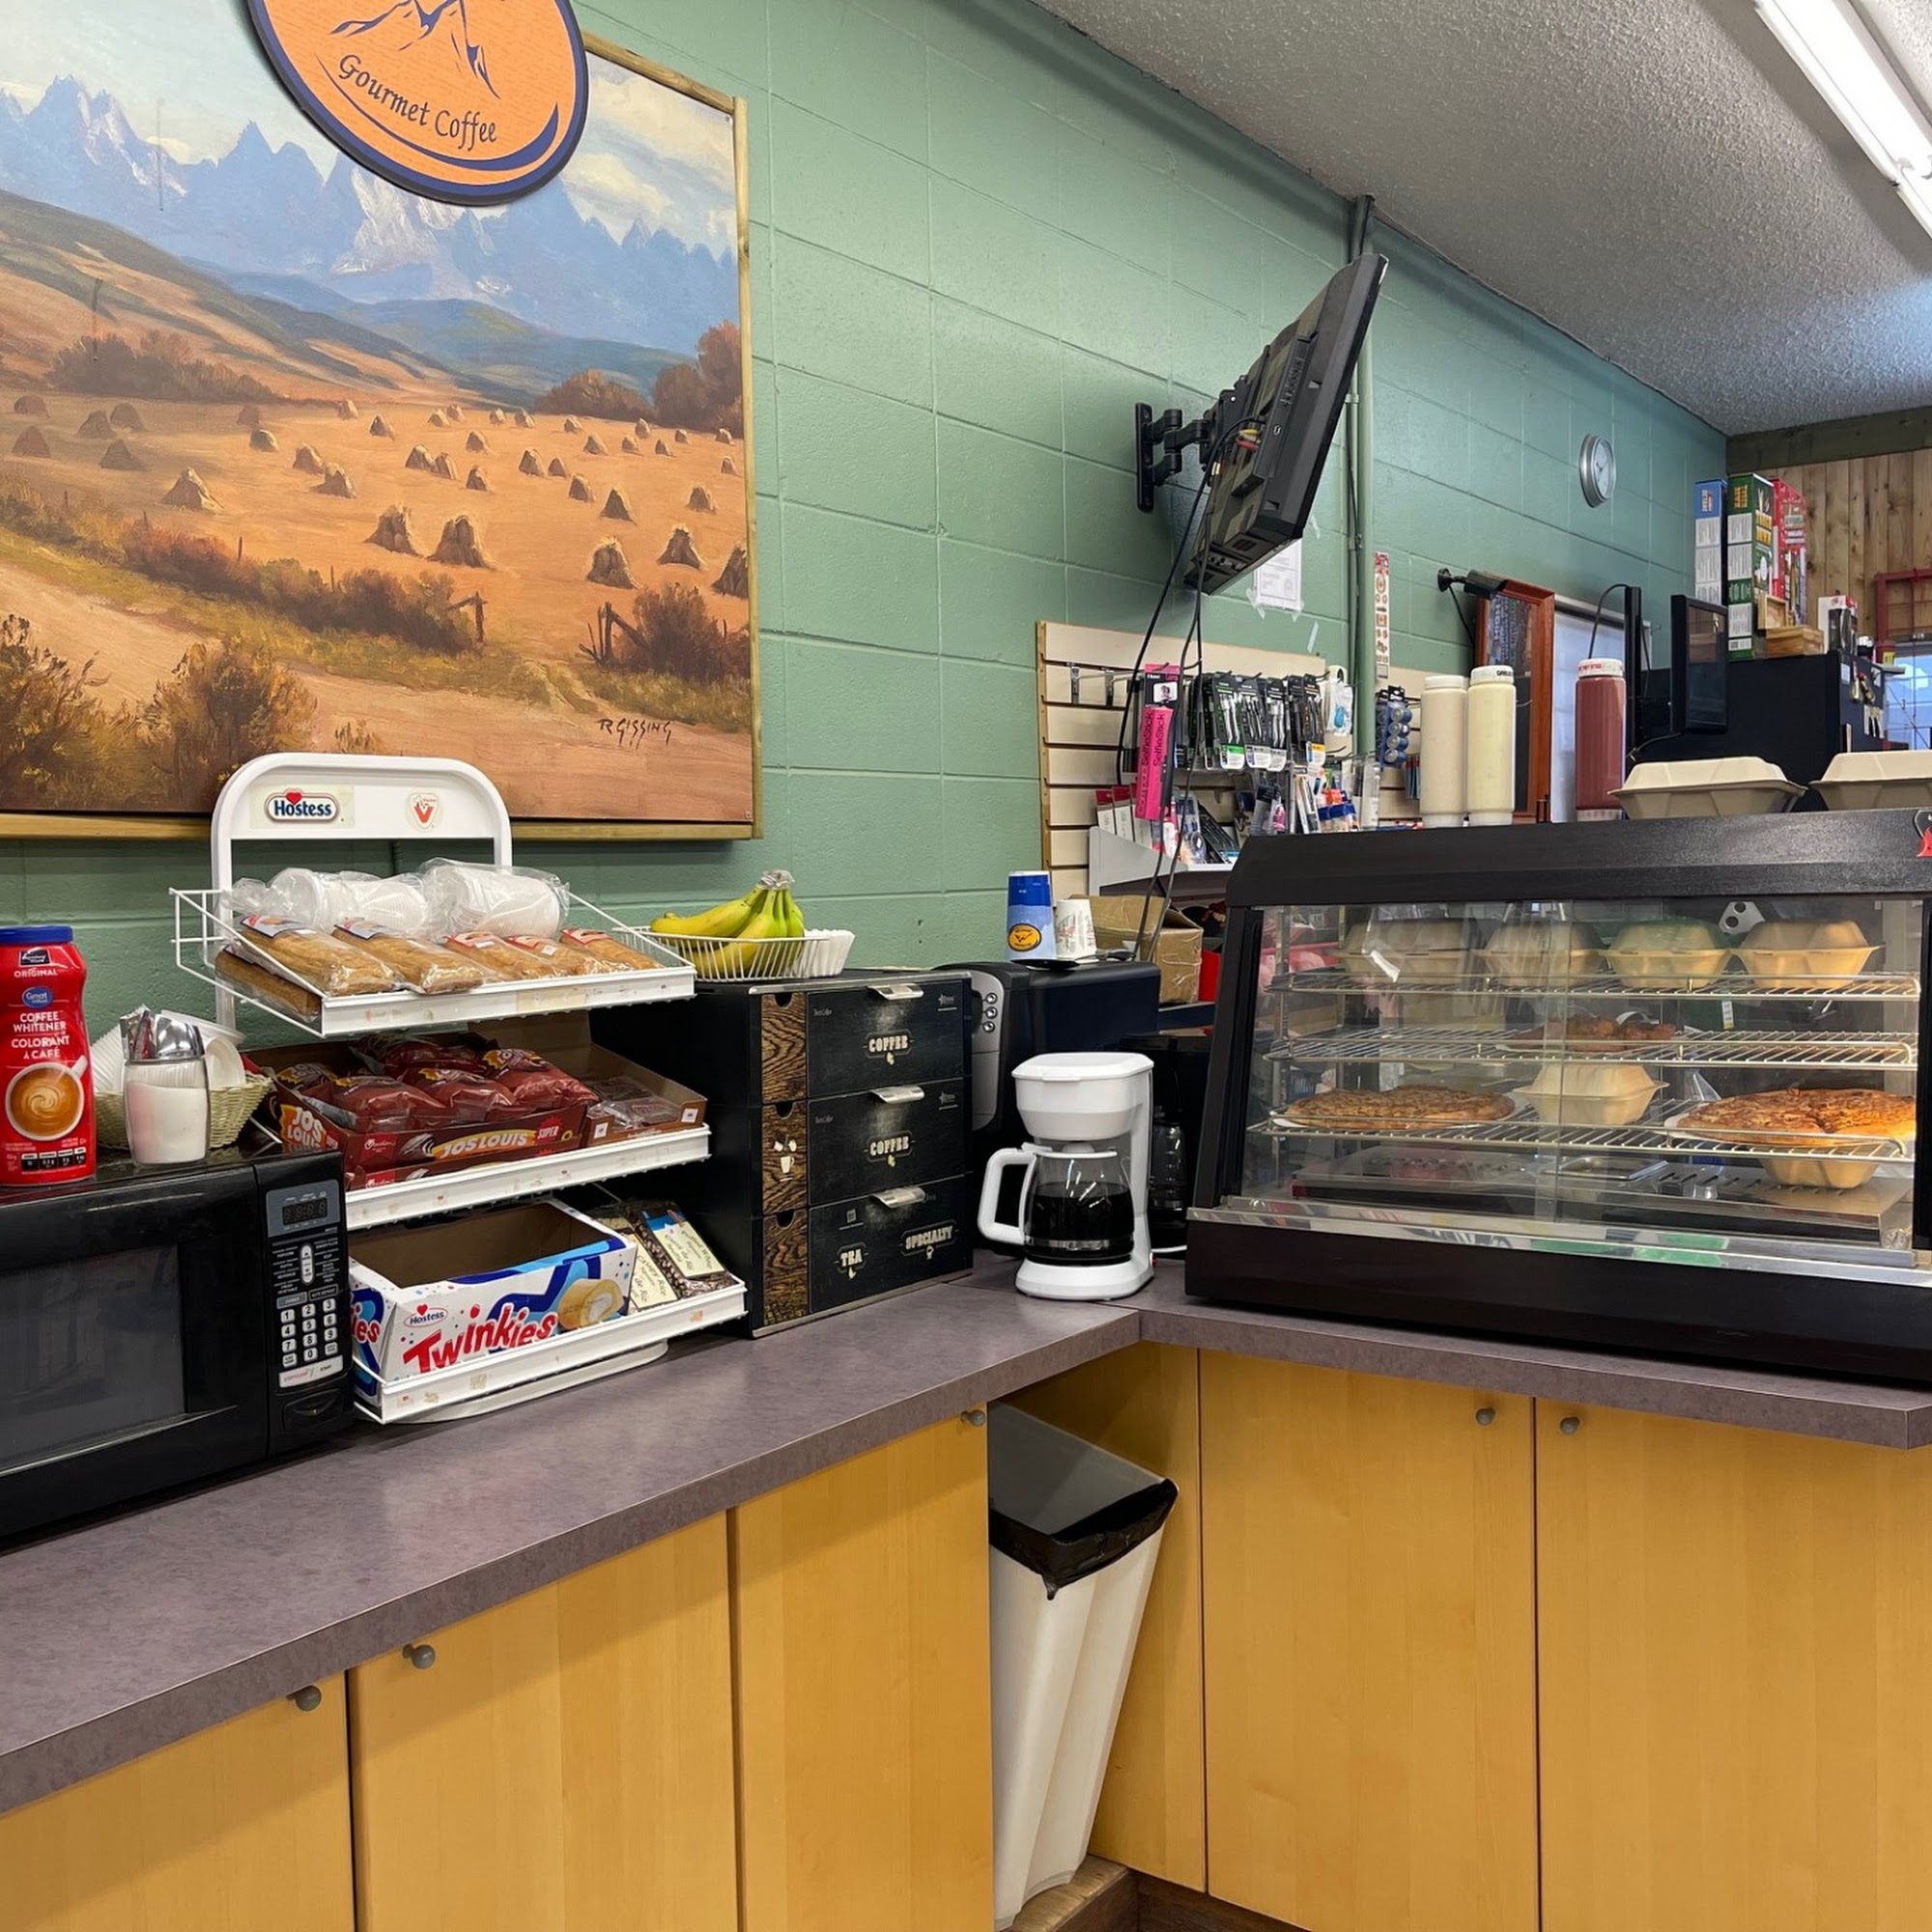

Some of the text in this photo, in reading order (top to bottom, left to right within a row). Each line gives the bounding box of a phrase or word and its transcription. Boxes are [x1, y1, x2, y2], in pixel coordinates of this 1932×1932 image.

[339, 54, 497, 151] Gourmet Coffee
[273, 800, 332, 817] Hostess
[14, 968, 58, 978] ORIGINAL
[19, 1011, 59, 1023] COFFEE
[13, 1021, 67, 1033] WHITENER
[11, 1035, 70, 1049] COLORANT
[869, 1035, 908, 1053] COFFEE
[292, 1106, 323, 1143] JOS
[537, 1125, 559, 1139] SUPER
[287, 1124, 321, 1148] LOUI
[440, 1132, 527, 1159] JOS LOUIS
[870, 1136, 909, 1156] COFFEE
[906, 1225, 953, 1250] SPECIALTY
[840, 1249, 863, 1267] TEA
[410, 1311, 445, 1323] Hostess
[403, 1303, 558, 1374] Twinkies
